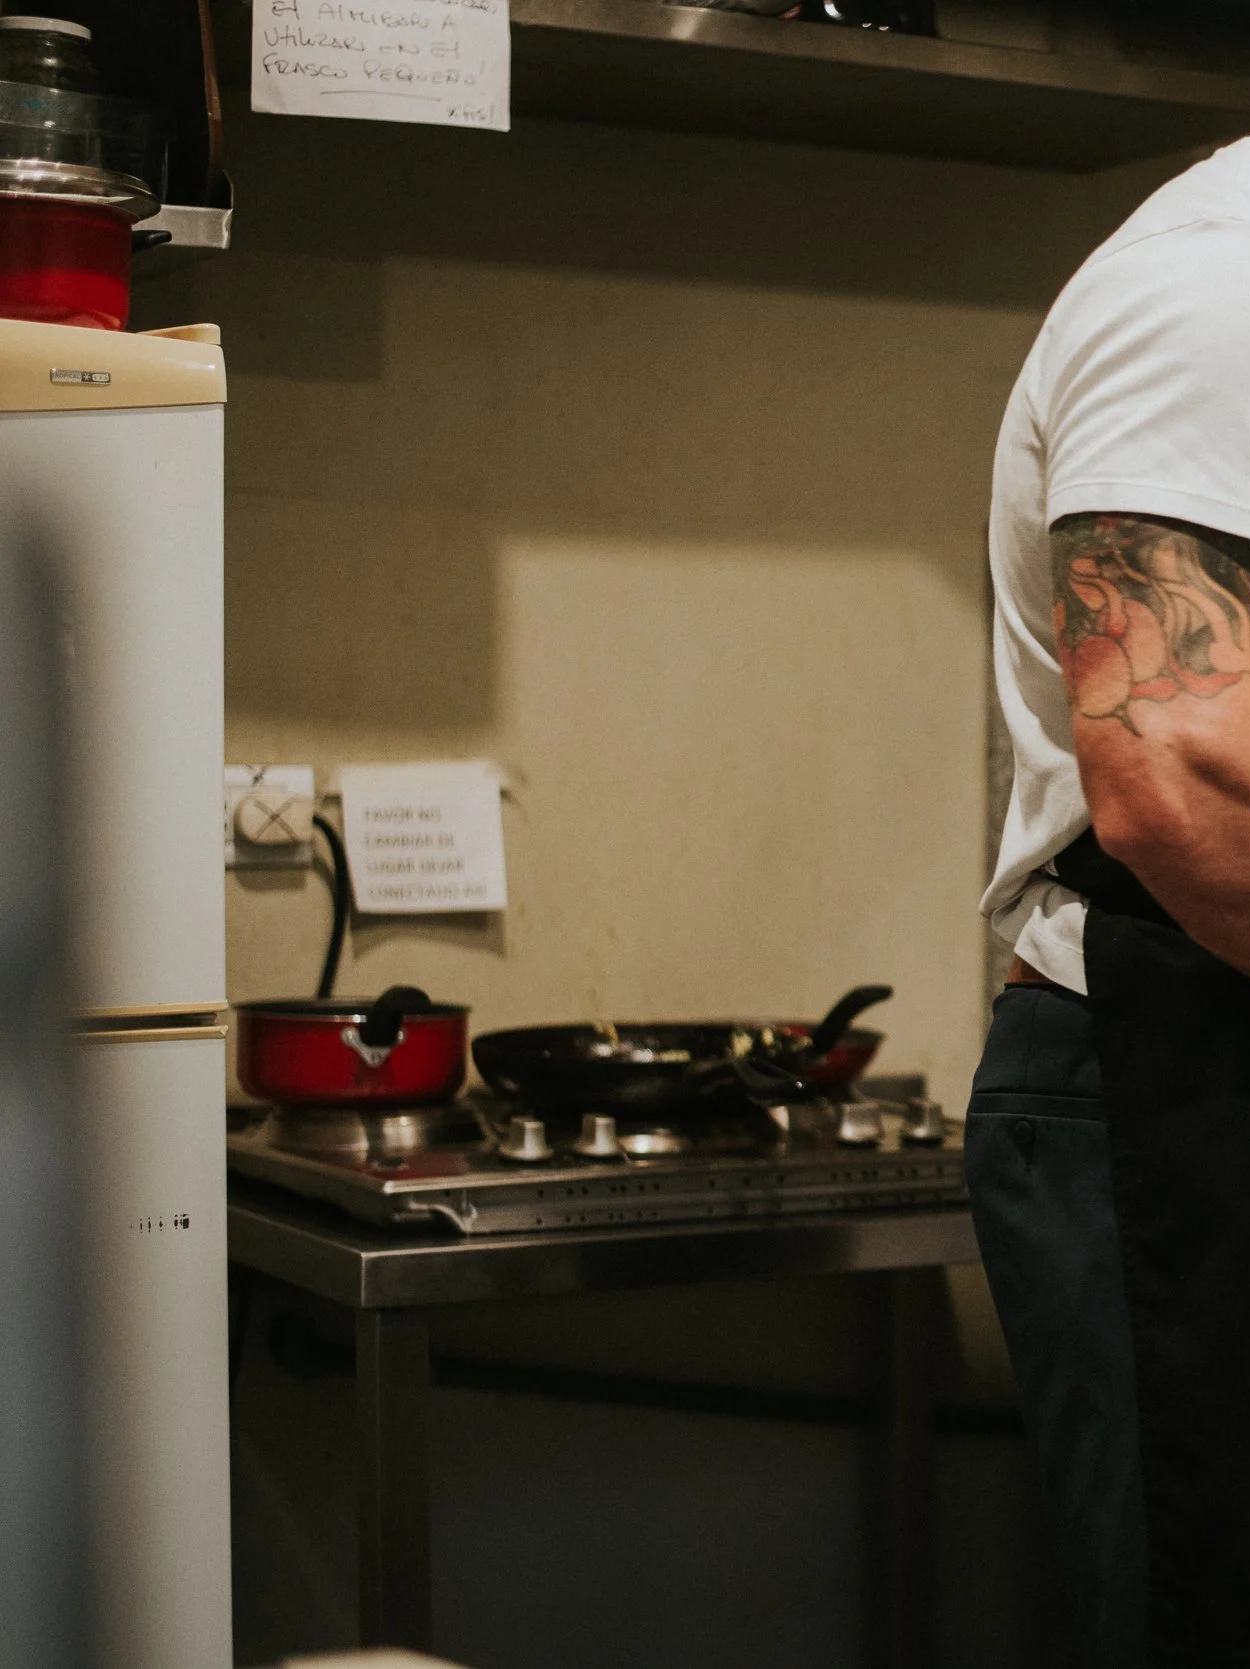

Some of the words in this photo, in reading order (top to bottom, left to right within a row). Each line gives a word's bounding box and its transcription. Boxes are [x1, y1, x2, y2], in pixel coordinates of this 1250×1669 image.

[441, 14, 457, 31] A
[262, 52, 349, 79] FRASCO
[364, 806, 413, 822] FAVOR
